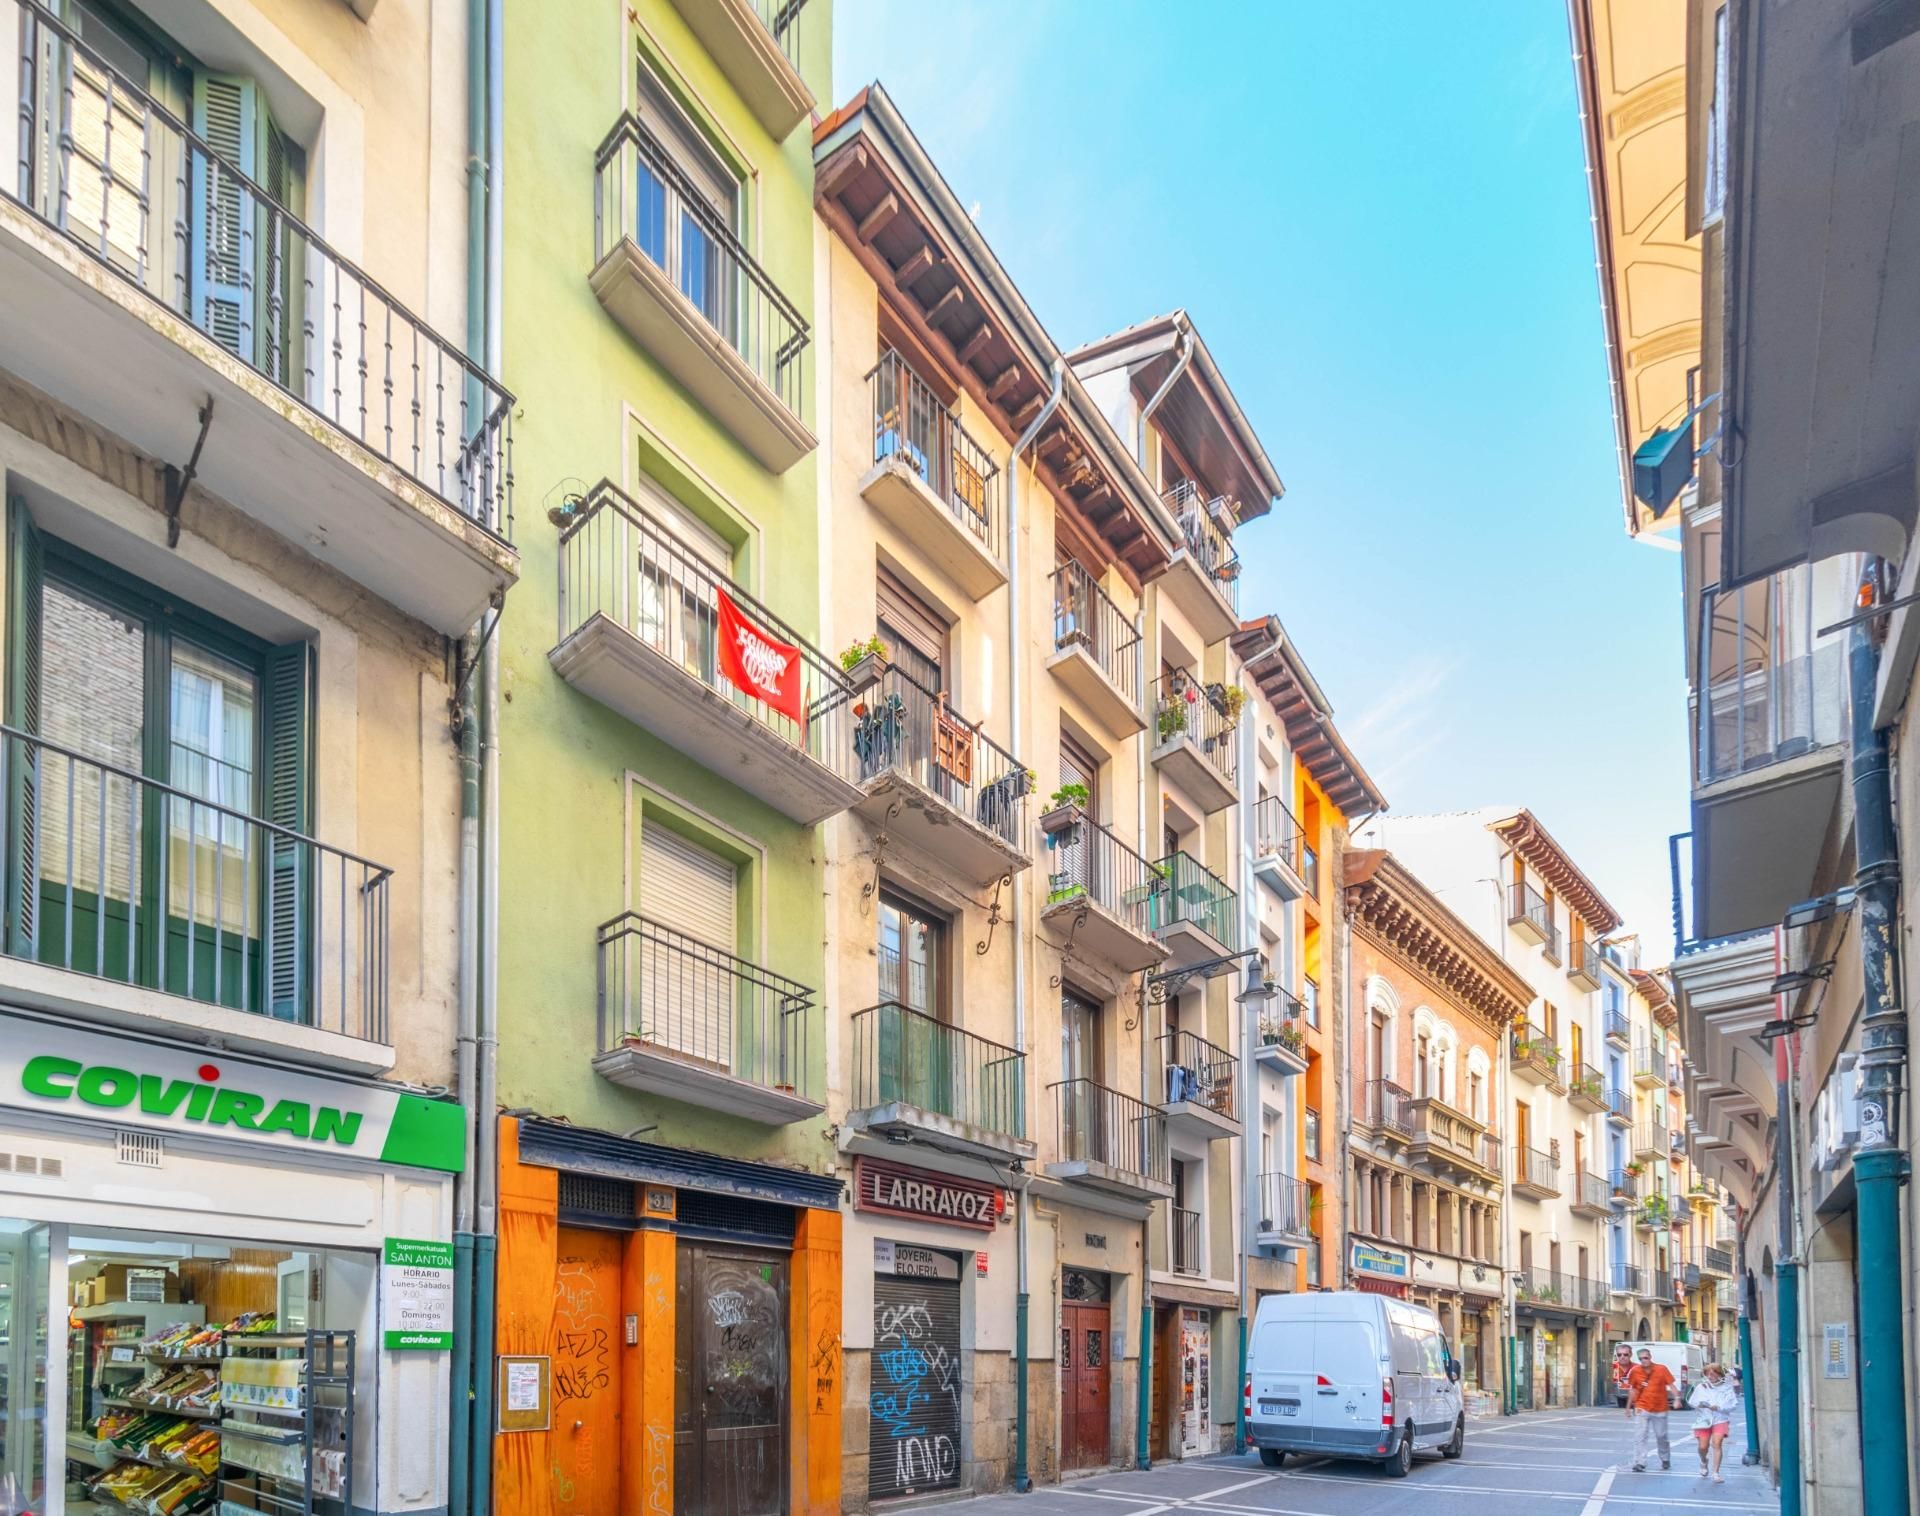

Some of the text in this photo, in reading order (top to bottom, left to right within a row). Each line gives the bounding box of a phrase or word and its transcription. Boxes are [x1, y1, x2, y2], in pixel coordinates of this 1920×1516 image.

[873, 1174, 992, 1222] LARRAYOZ
[390, 1252, 452, 1266] SAN ANTON
[896, 1248, 933, 1263] JOYERIA
[403, 1269, 440, 1278] HORARIO
[401, 1311, 441, 1320] Domingos
